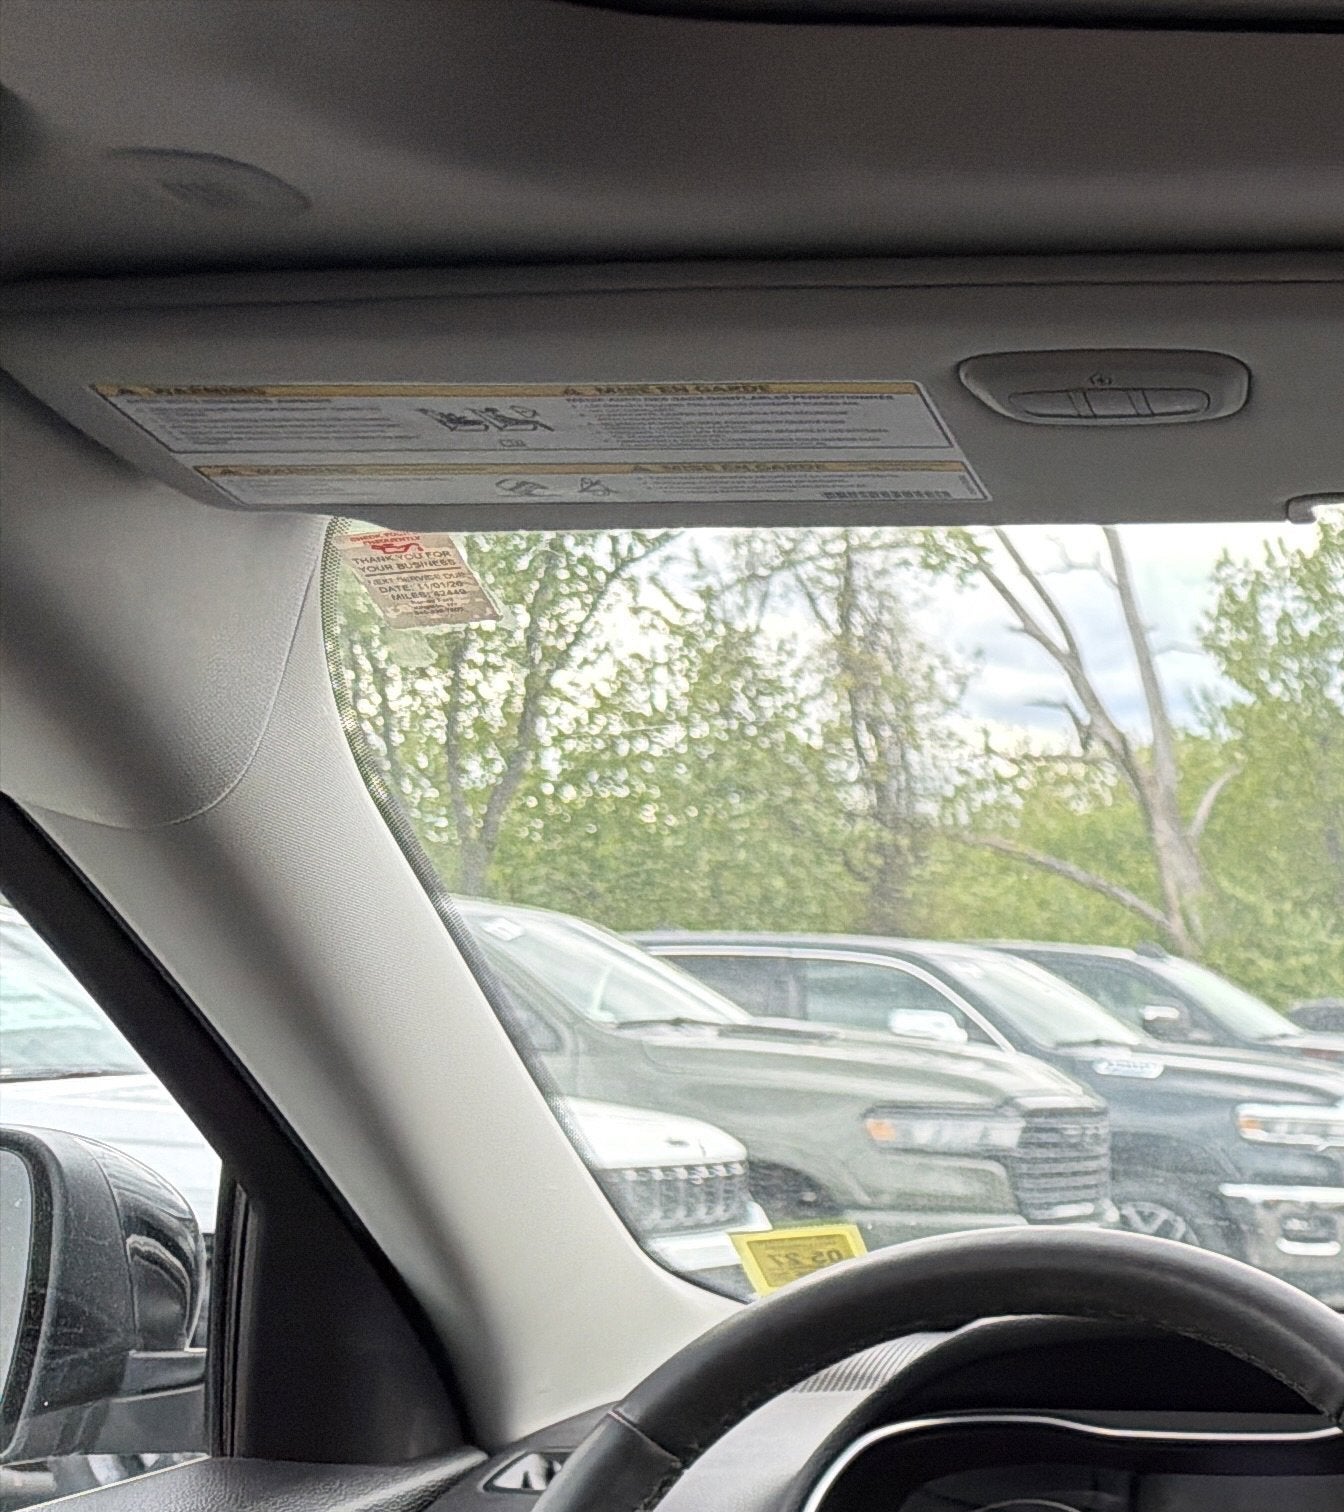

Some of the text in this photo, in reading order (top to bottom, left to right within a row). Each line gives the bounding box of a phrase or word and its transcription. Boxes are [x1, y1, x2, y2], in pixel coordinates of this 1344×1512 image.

[352, 550, 452, 564] THANK YOU FOR
[358, 559, 457, 573] YOUR BUSINESS
[379, 584, 413, 594] DATE:
